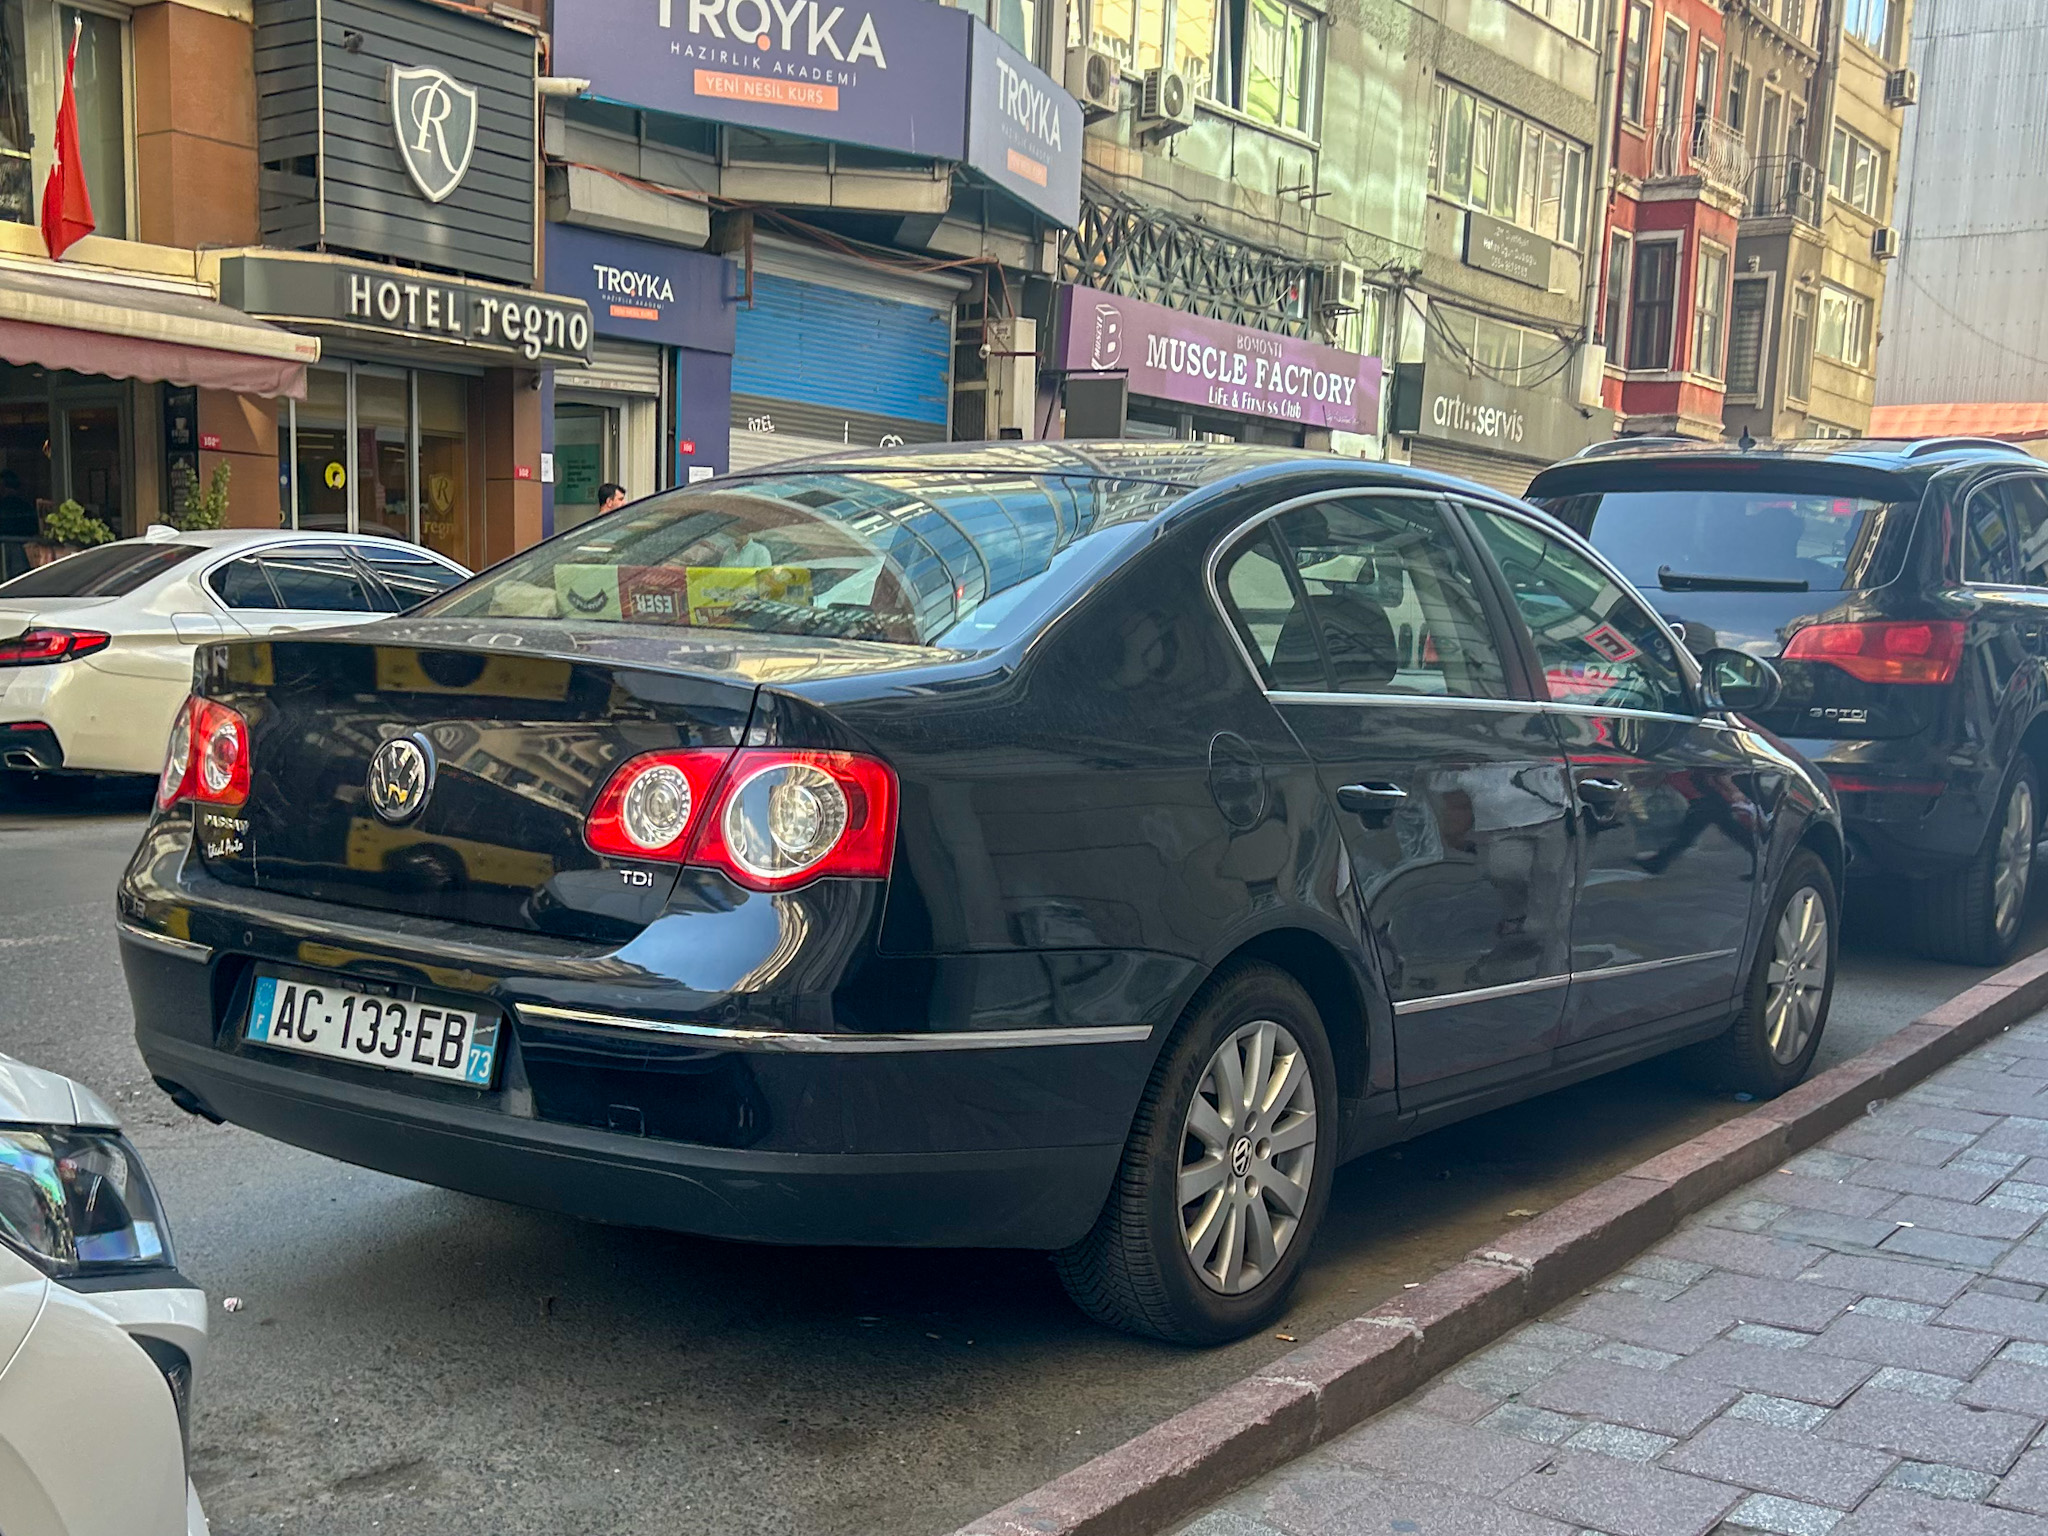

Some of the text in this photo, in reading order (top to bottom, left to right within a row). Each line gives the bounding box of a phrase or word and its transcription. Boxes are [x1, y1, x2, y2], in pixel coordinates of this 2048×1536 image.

[671, 41, 857, 87] HAZIRLIK AKADEMİ
[705, 76, 824, 104] YENİ NESİL KURS
[996, 57, 1061, 152] TROYKA
[410, 79, 458, 175] R
[593, 264, 675, 303] TROYKA
[351, 274, 588, 360] HOTEL regno
[1146, 334, 1356, 406] MUSCLE FACTORY
[1231, 389, 1239, 408] &
[1281, 399, 1302, 419] Club
[620, 870, 653, 887] TDI
[256, 1013, 264, 1030] F
[468, 1048, 492, 1078] 73
